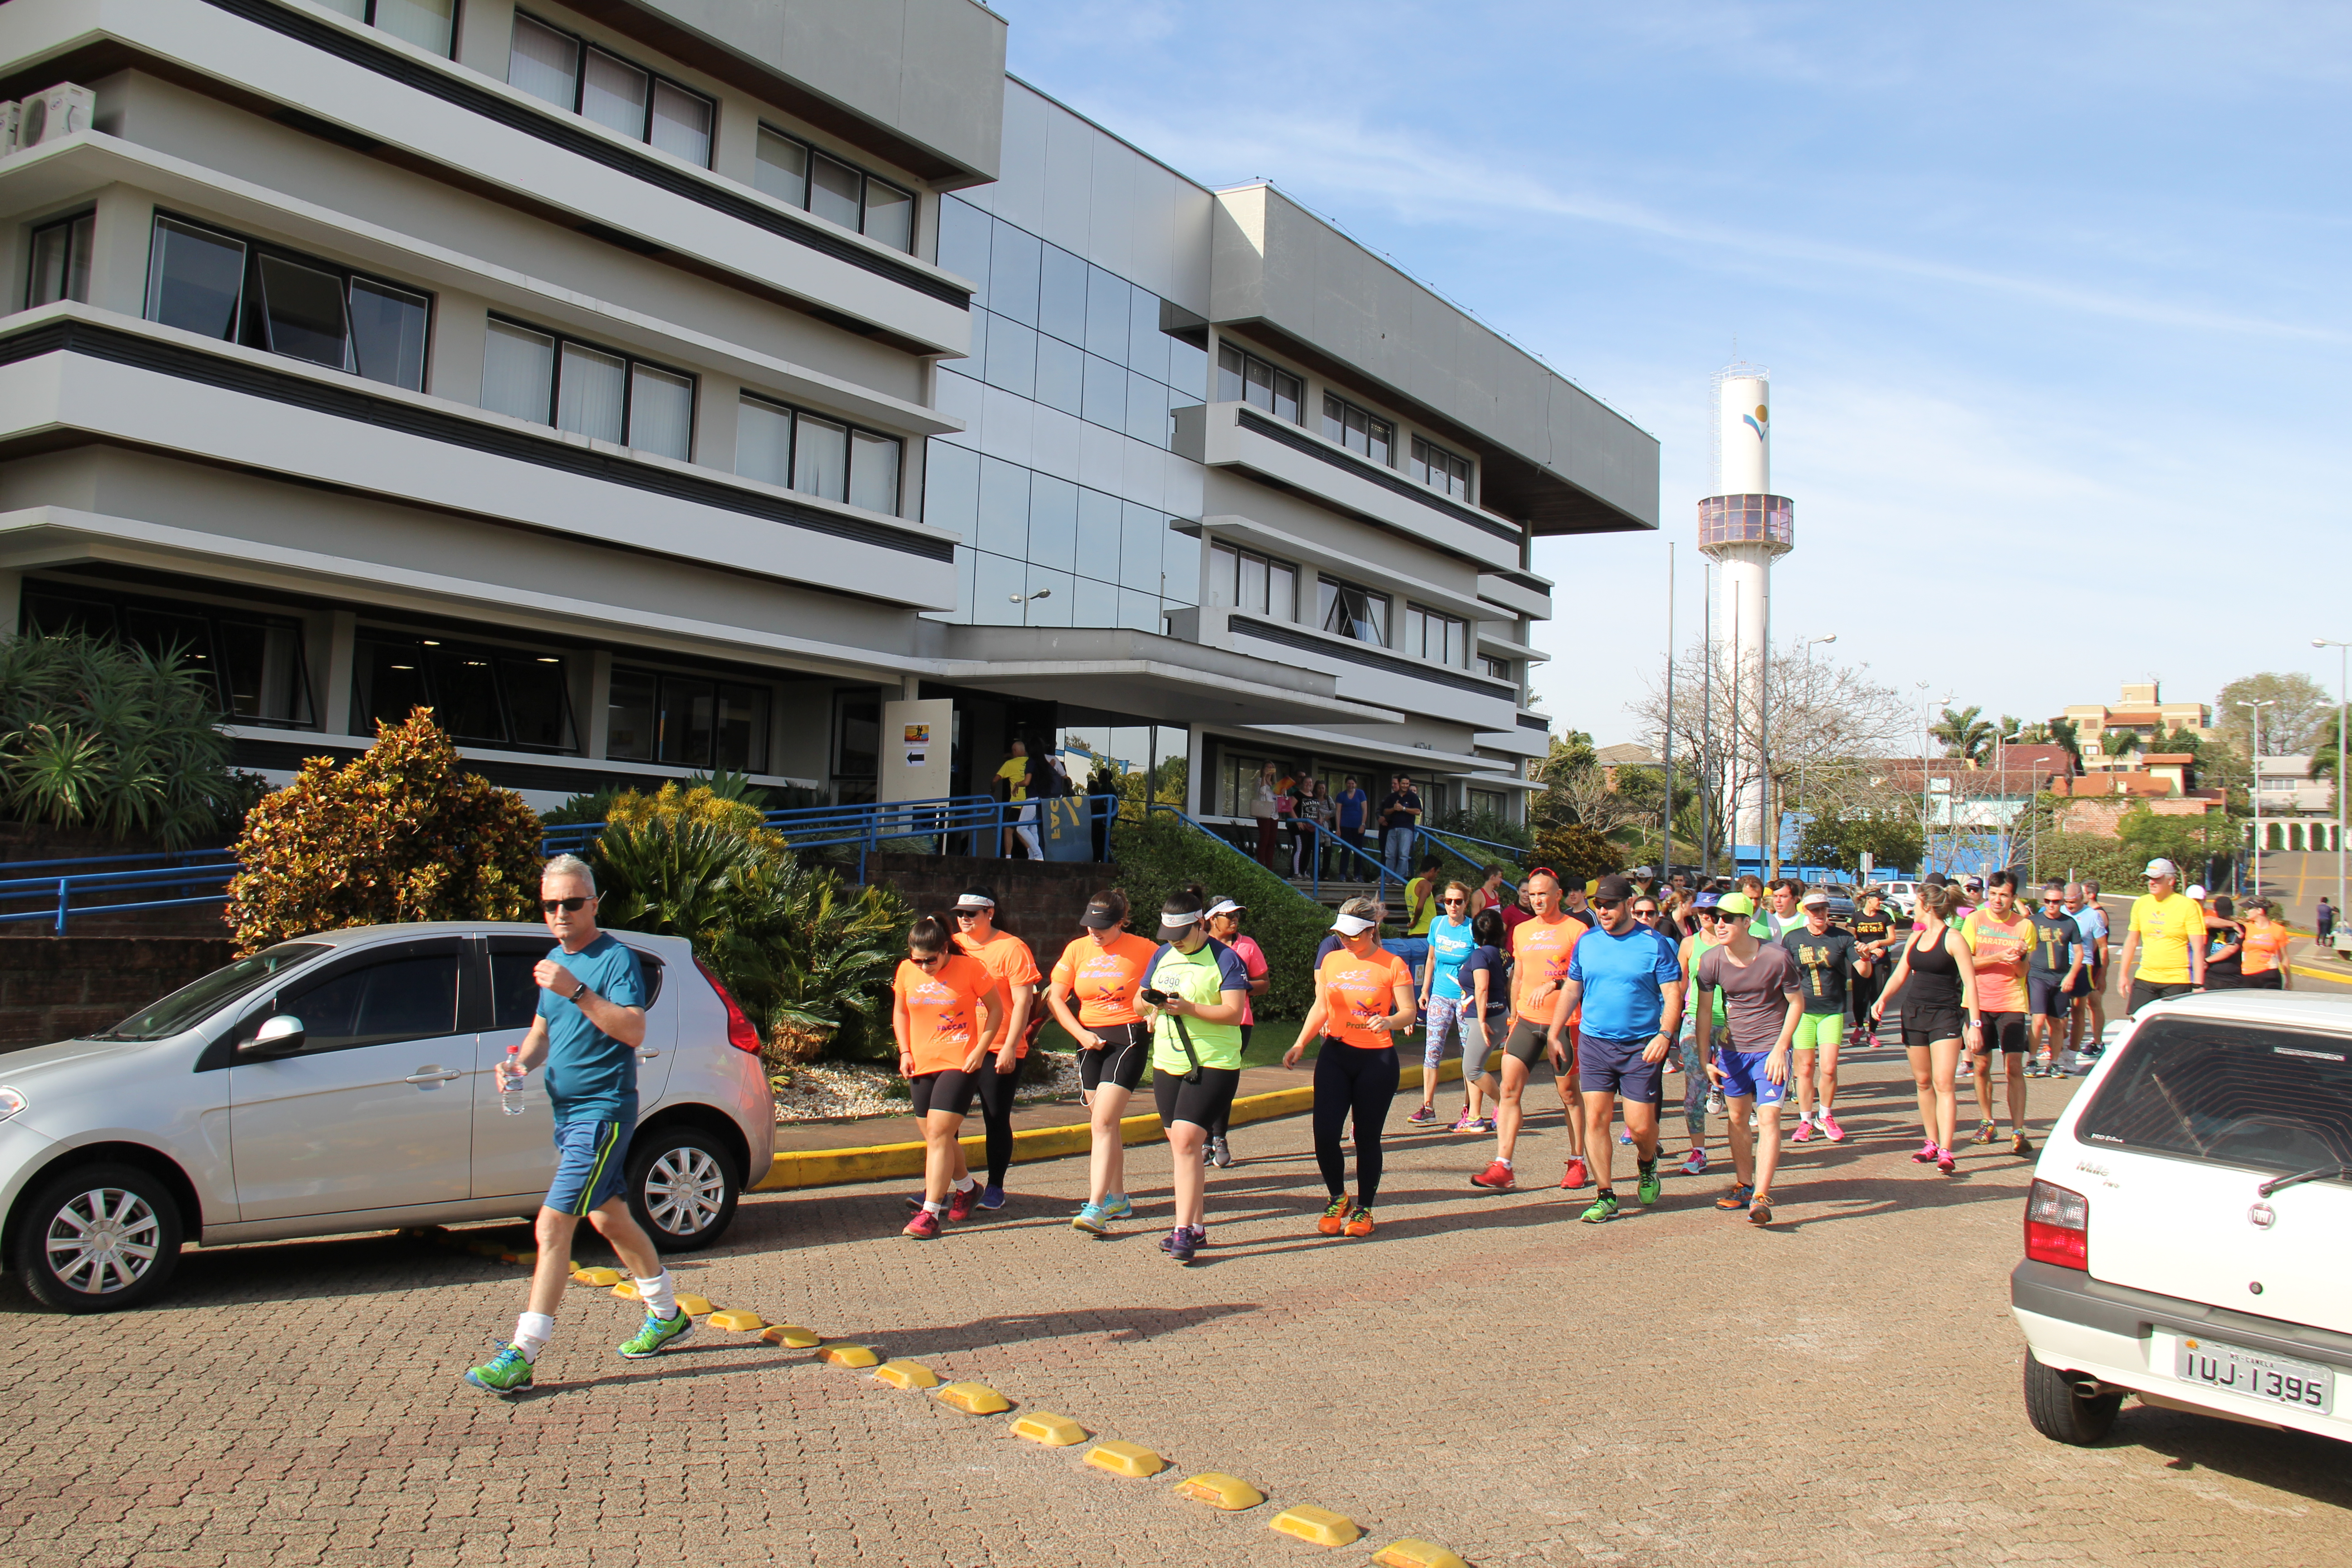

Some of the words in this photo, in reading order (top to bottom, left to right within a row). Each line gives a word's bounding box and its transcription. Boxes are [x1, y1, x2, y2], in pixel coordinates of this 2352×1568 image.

[1436, 936, 1467, 949] energia
[1158, 974, 1180, 987] Lago
[1338, 982, 1377, 992] Movere
[937, 1022, 967, 1031] FACCAT
[2253, 1208, 2273, 1224] FIAT
